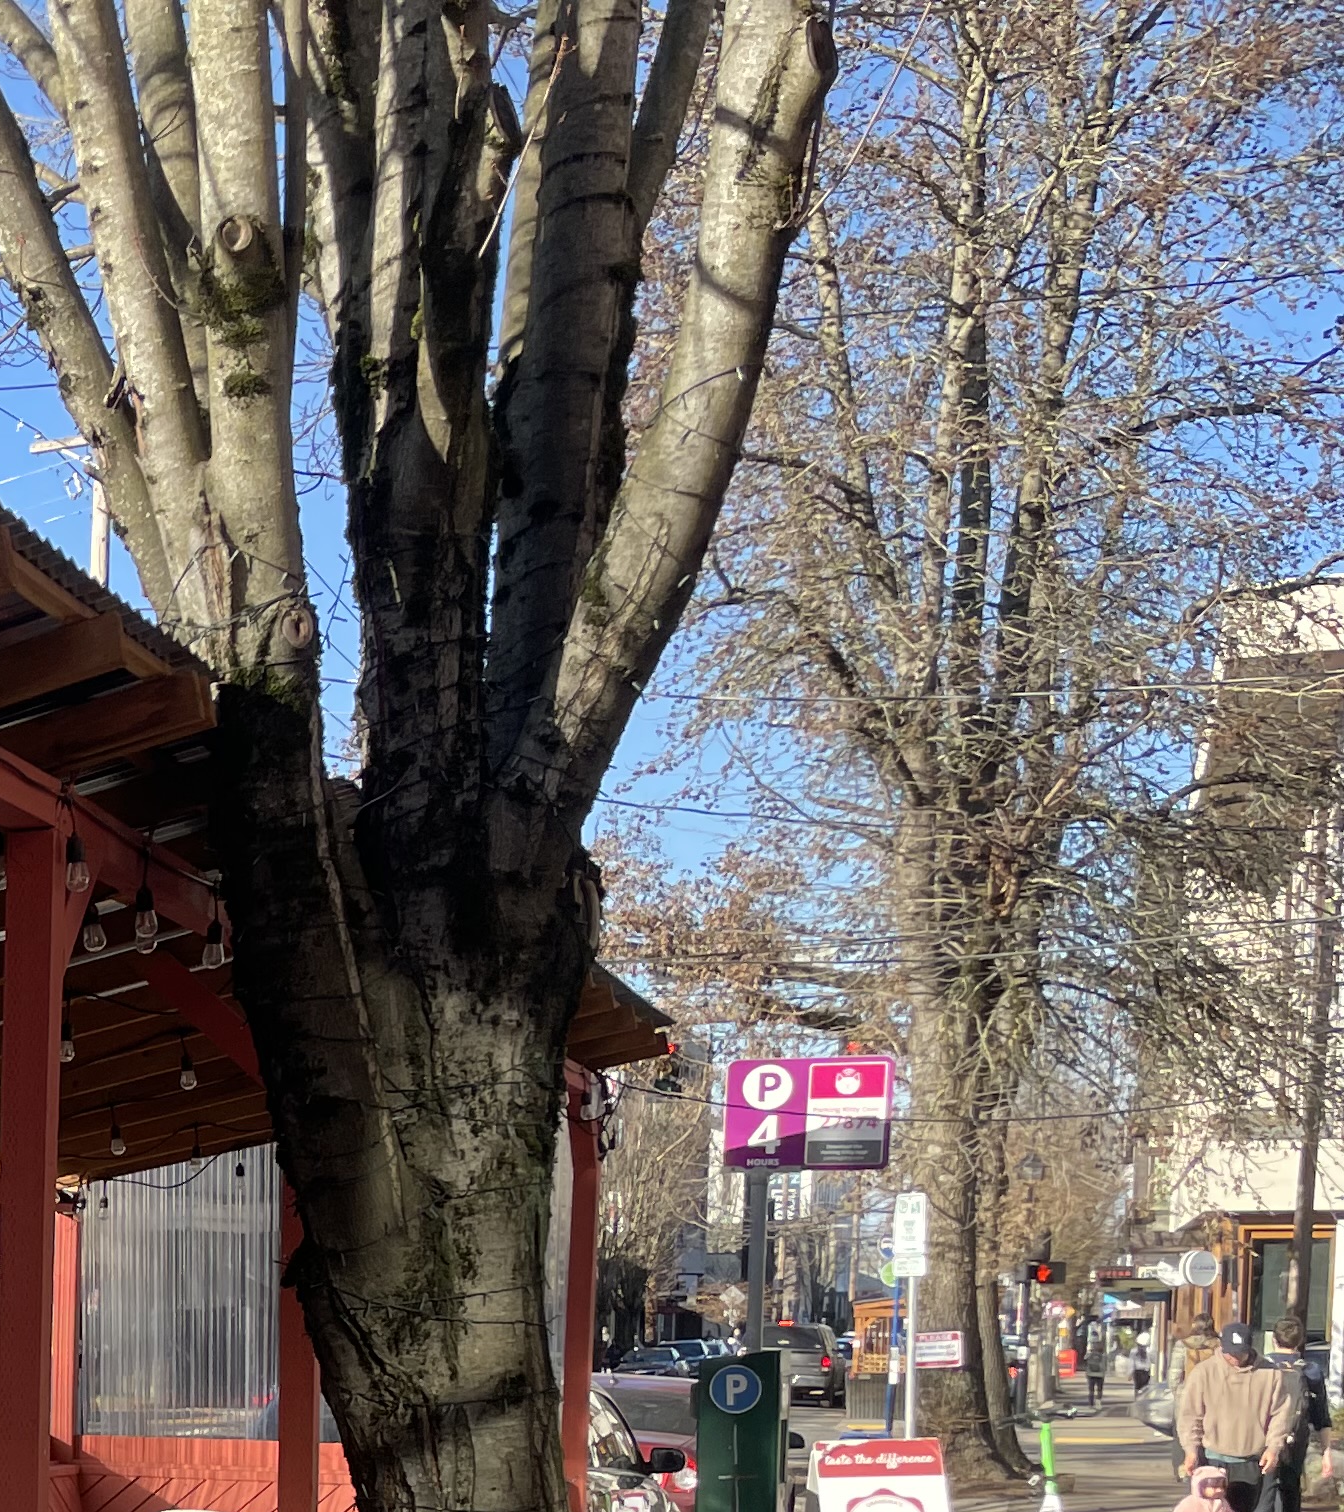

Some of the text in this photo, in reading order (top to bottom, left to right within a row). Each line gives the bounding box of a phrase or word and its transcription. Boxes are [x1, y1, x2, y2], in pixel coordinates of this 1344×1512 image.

[758, 1072, 782, 1102] P
[747, 1114, 781, 1154] 4
[746, 1158, 780, 1167] HOURS
[725, 1373, 748, 1406] P
[824, 1452, 936, 1470] taste the difference
